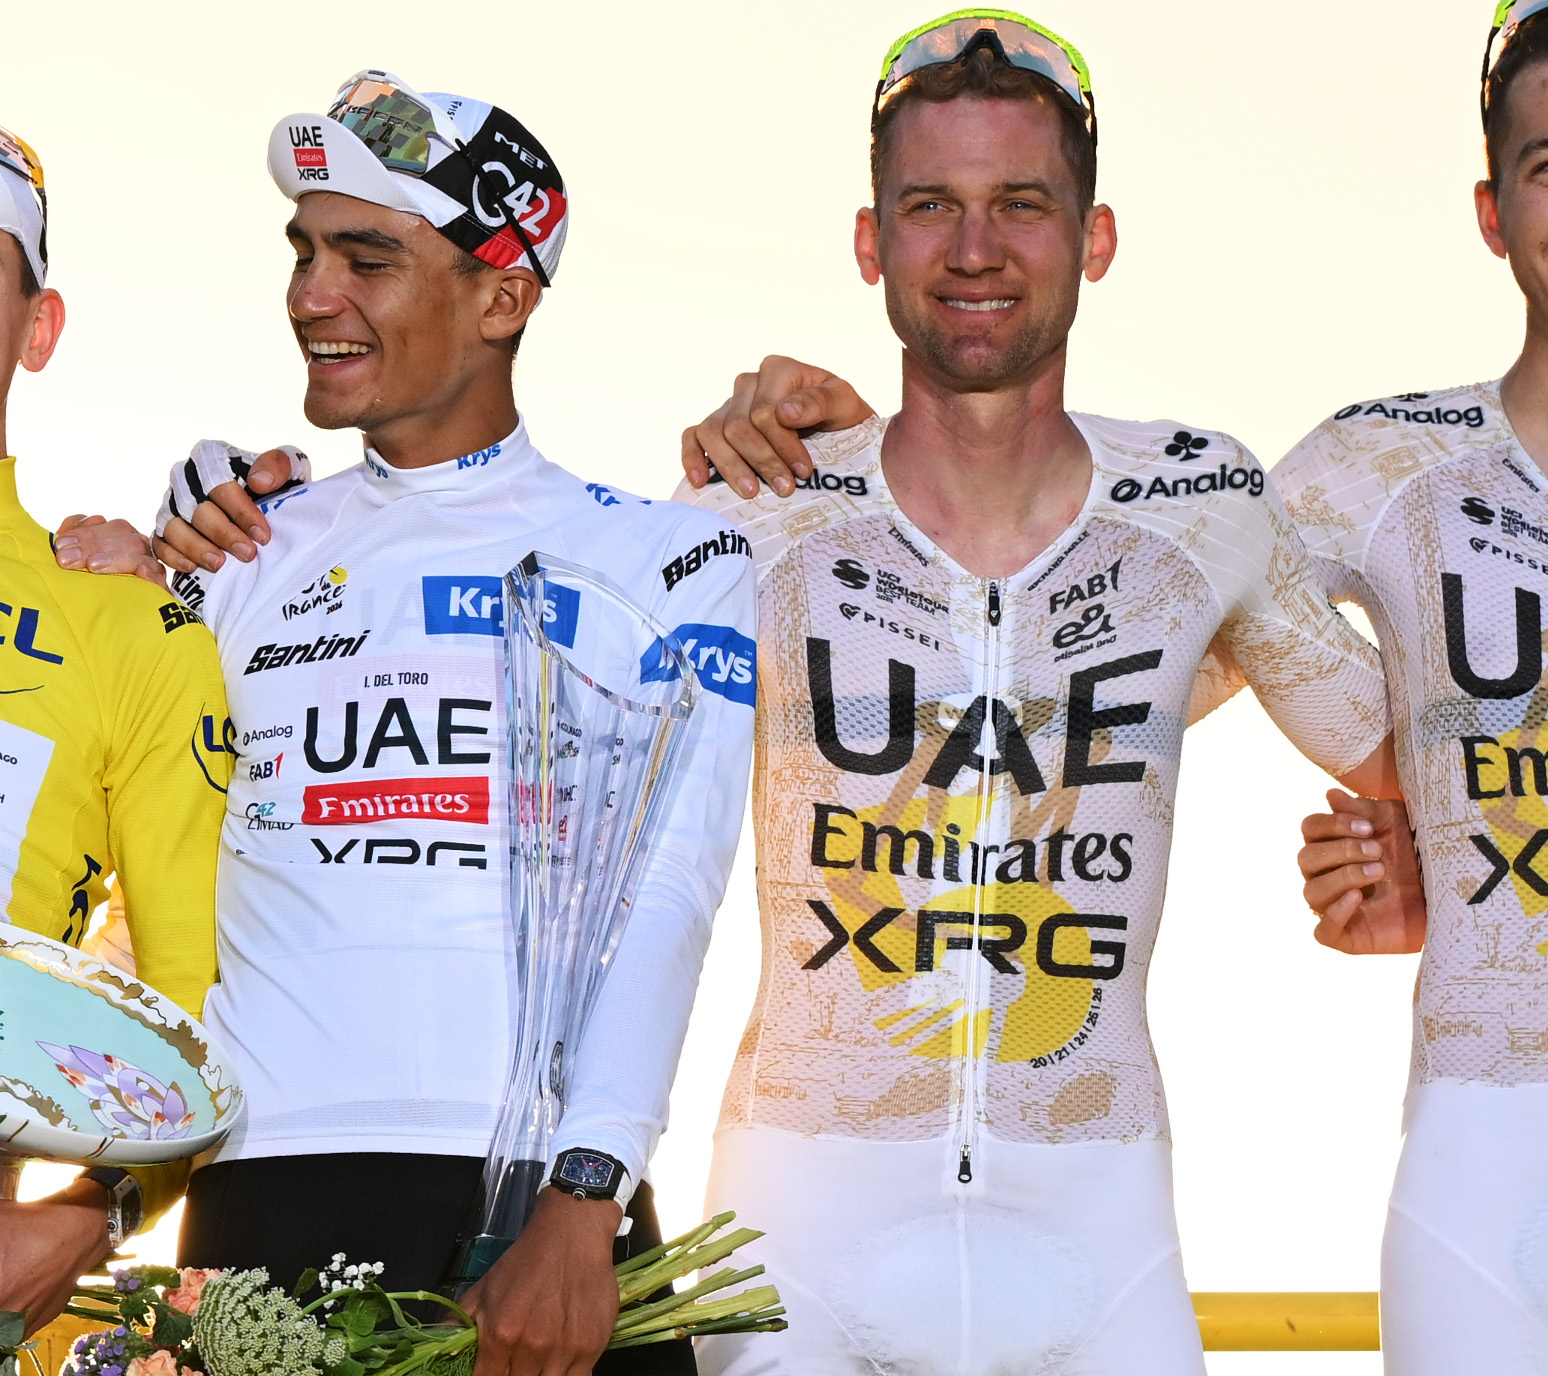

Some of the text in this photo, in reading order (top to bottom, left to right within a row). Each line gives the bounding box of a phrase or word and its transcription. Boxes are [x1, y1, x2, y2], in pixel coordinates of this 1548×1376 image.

[289, 126, 324, 147] UAE
[494, 131, 548, 171] MET
[297, 152, 323, 163] Emirates
[297, 168, 329, 181] XRG
[1363, 402, 1485, 428] Analog
[457, 443, 501, 470] Krys
[1145, 464, 1264, 500] Analog
[1501, 505, 1523, 519] UCI
[877, 568, 902, 583] UCI
[875, 584, 937, 615] BEST TEAM
[876, 577, 950, 614] WORLDTOUR
[864, 611, 941, 651] PISSEI
[1094, 634, 1117, 650] and
[243, 630, 371, 675] Santini
[364, 672, 429, 688] I. DEL TORO
[805, 637, 1164, 797] UAE
[251, 725, 293, 743] Analog
[304, 697, 492, 773] UAE
[810, 804, 1134, 885] Emirates
[802, 899, 1128, 980] XRG
[1030, 987, 1102, 1069] 20 21 24 26
